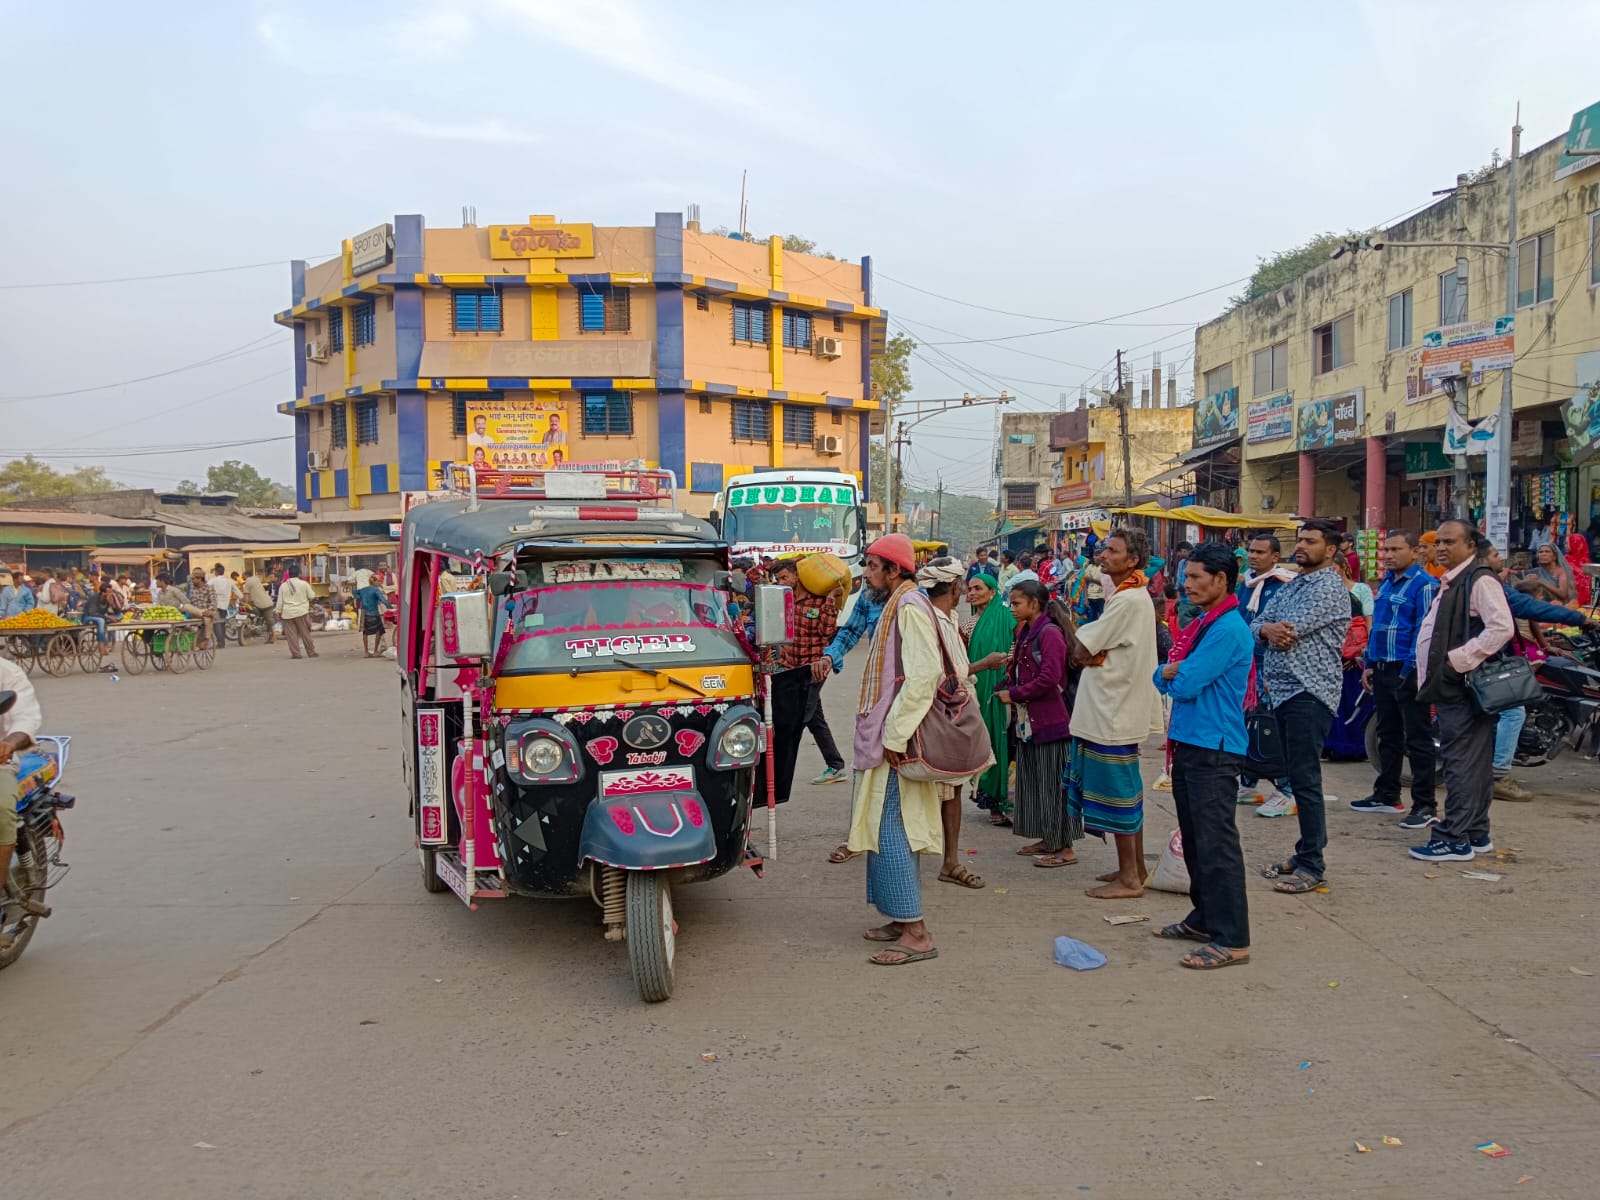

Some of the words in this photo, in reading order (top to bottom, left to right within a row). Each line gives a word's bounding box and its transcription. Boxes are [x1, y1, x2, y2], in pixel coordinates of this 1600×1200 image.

[354, 235, 371, 255] SPOT
[372, 231, 385, 247] ON
[730, 485, 852, 507] SHUBHAM
[565, 633, 696, 660] TIGER
[702, 679, 726, 689] GEM
[626, 752, 639, 765] Ya
[640, 750, 667, 764] babji
